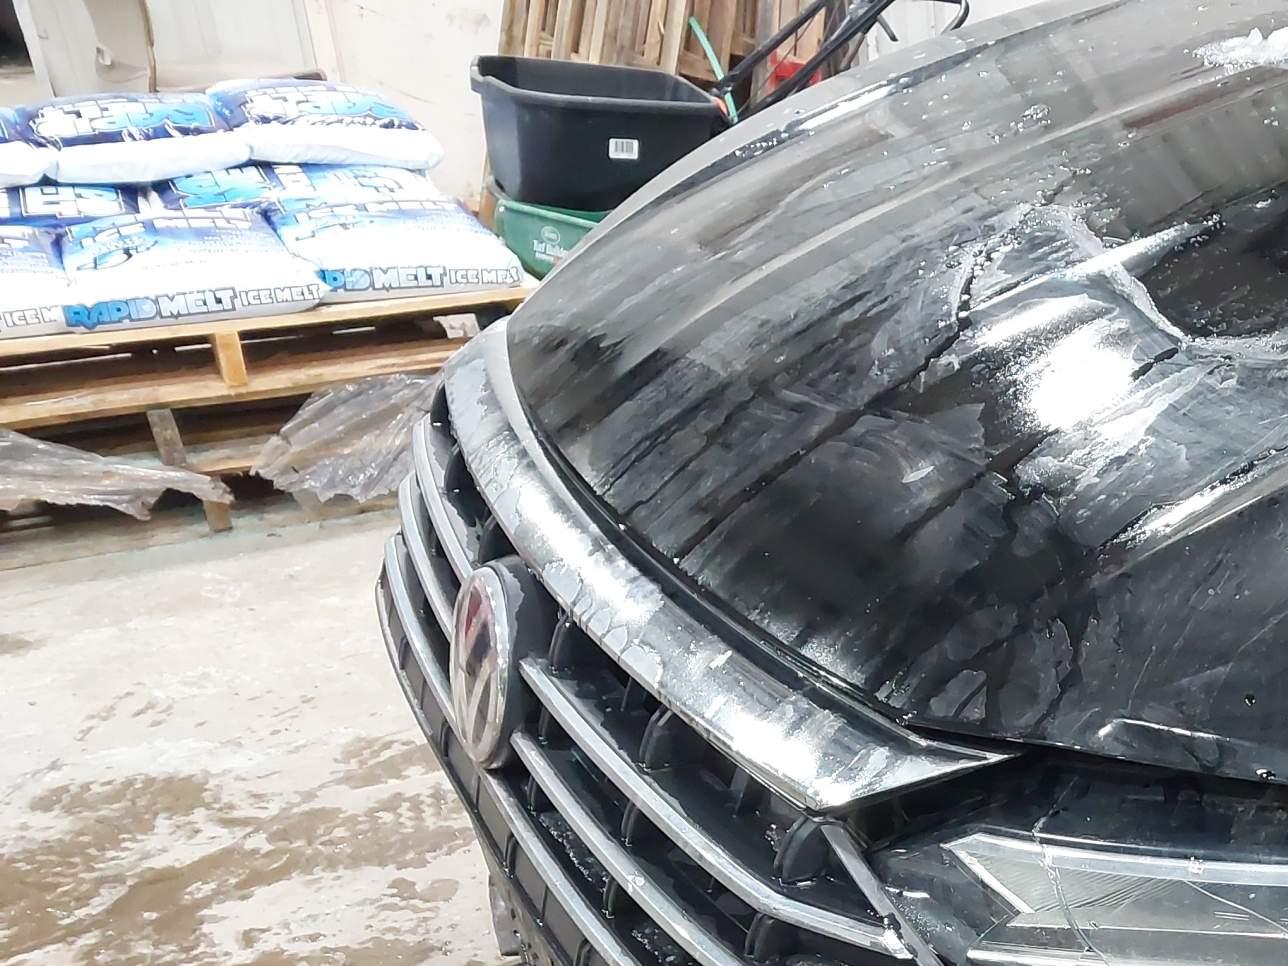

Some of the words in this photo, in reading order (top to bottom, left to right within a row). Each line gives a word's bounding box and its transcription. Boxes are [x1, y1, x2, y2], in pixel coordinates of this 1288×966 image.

[372, 265, 446, 292] MELT
[449, 268, 480, 285] ICE
[3, 308, 40, 328] ICE
[62, 296, 157, 330] RAPID
[158, 286, 237, 320] MELT
[239, 289, 273, 306] ICE
[273, 284, 321, 305] MELT
